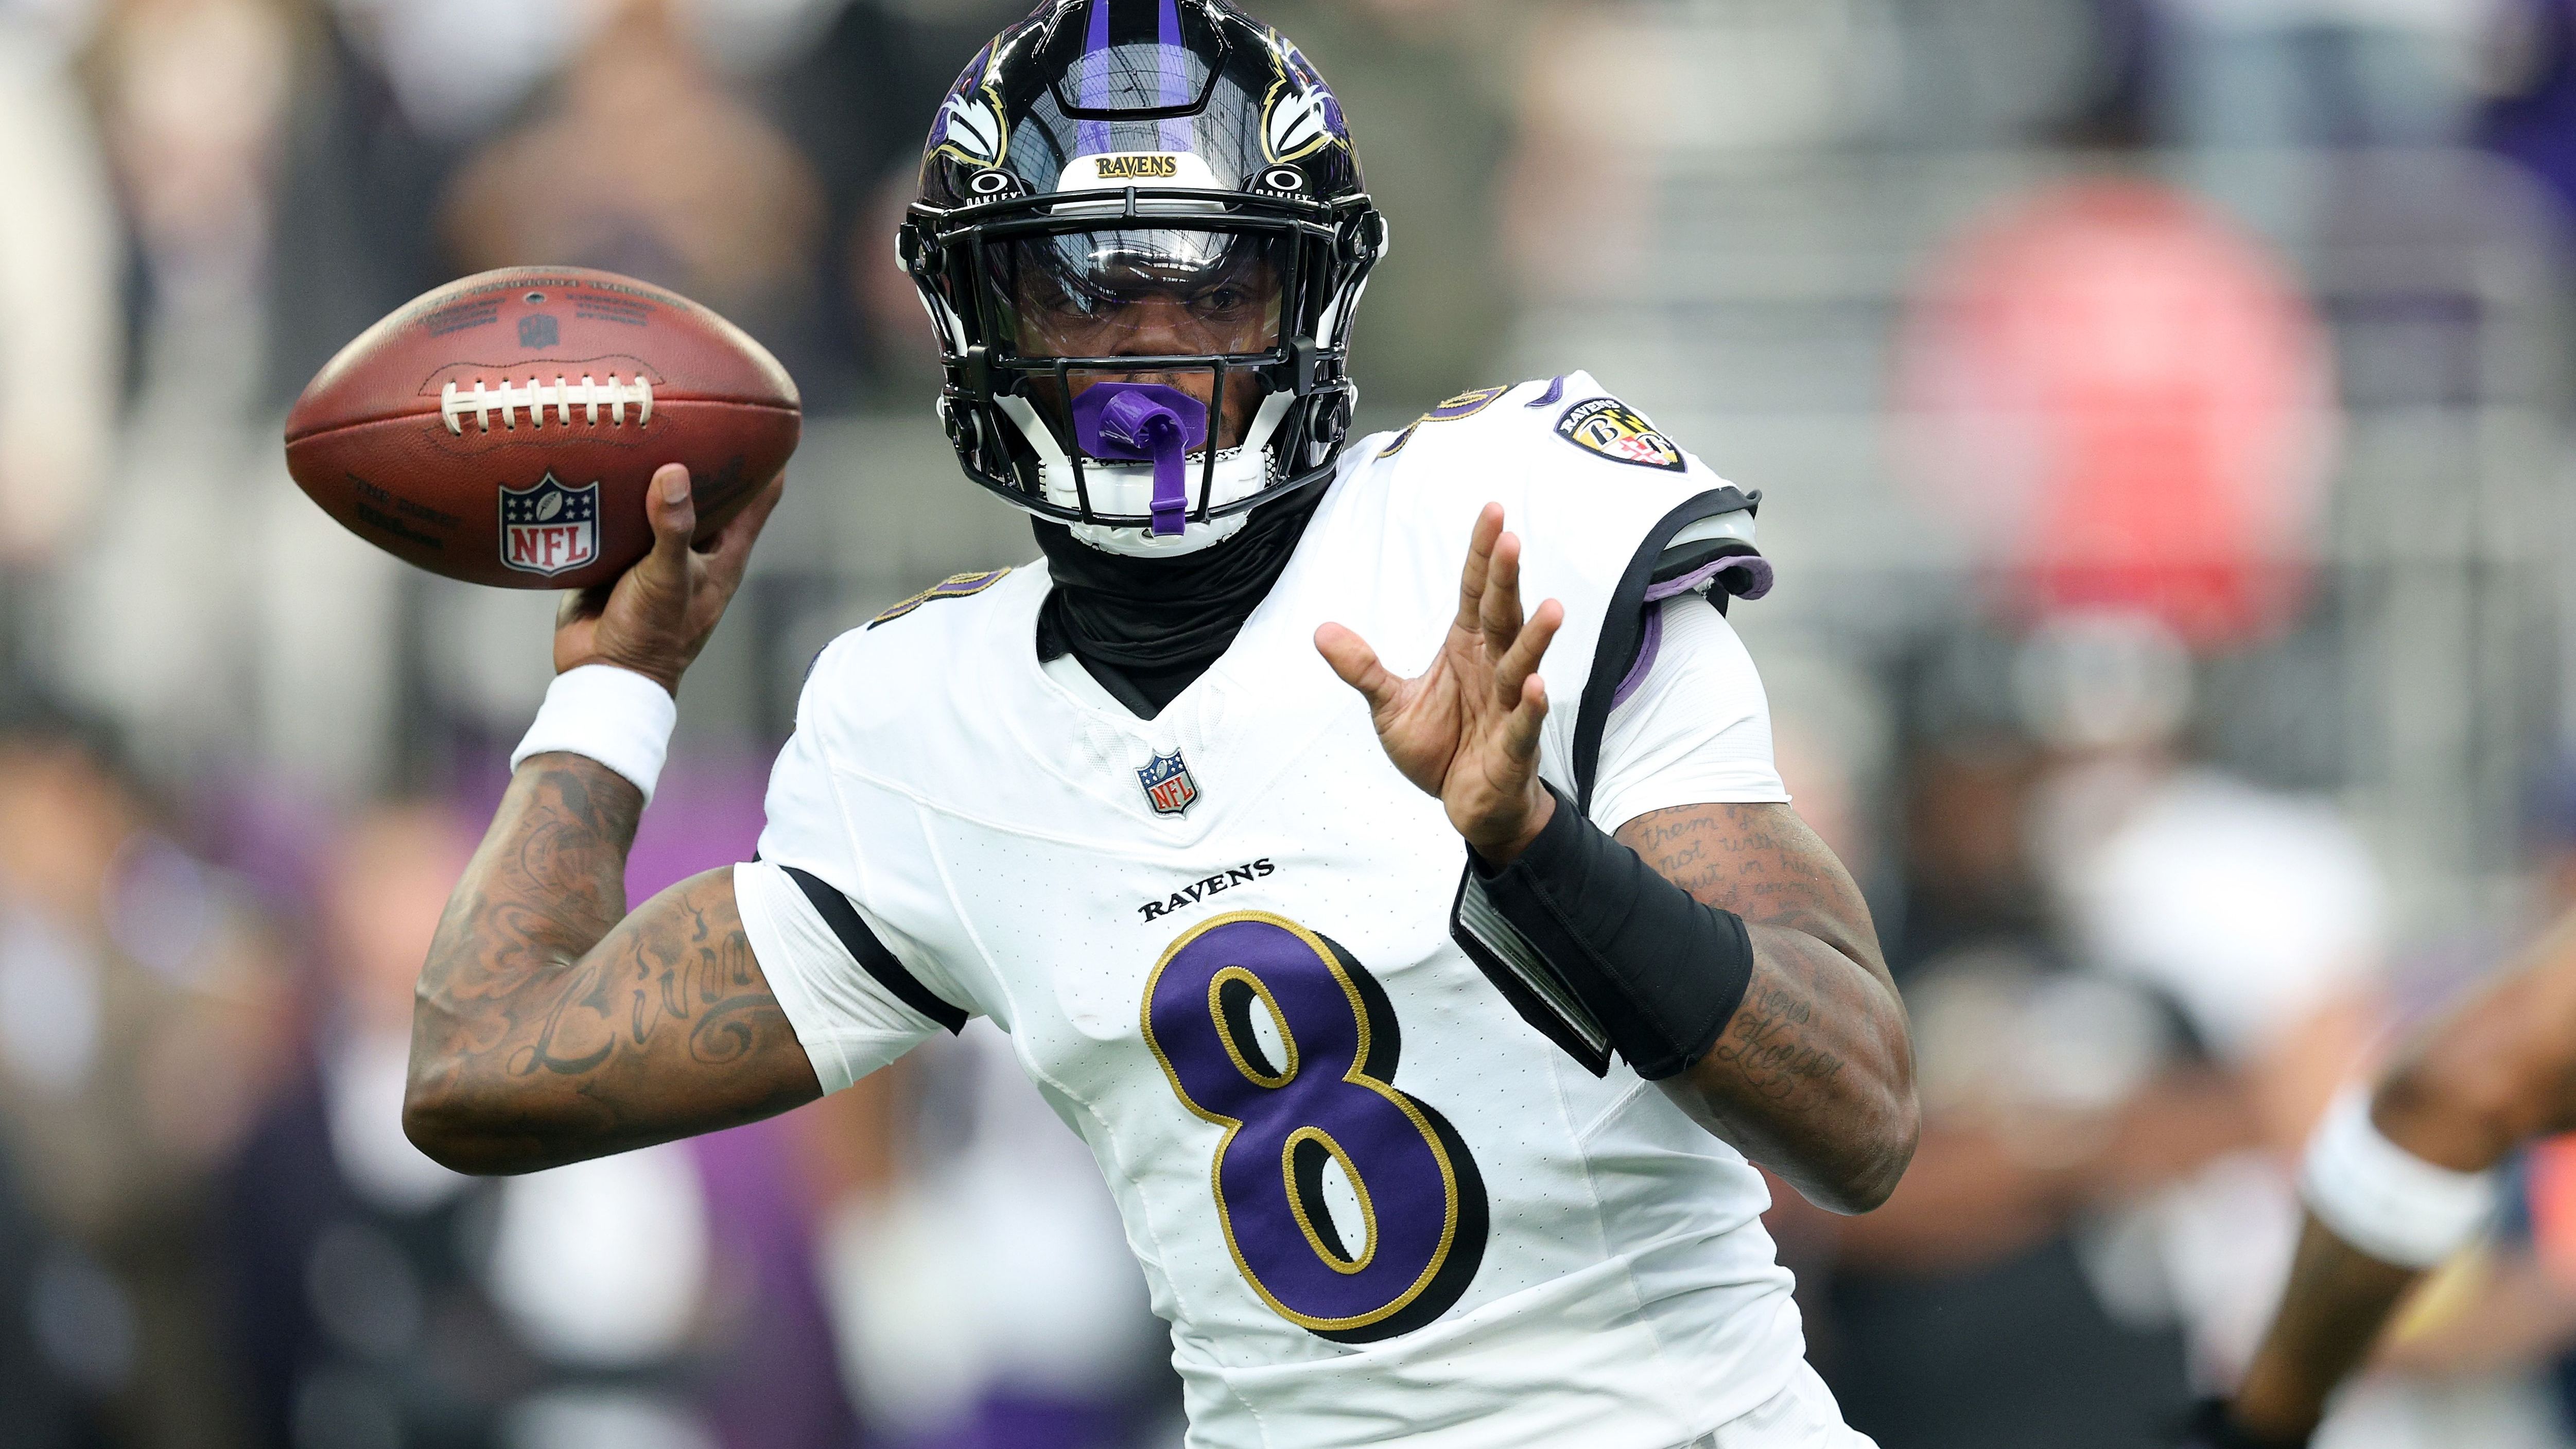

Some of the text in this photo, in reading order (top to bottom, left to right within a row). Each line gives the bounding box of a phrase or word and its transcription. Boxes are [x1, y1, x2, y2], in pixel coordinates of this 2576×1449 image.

[1095, 156, 1177, 180] RAVENS
[1560, 399, 1621, 434] RAVENS
[511, 526, 588, 568] NFL
[1150, 776, 1193, 809] NFL
[1138, 858, 1275, 923] RAVENS
[1140, 910, 1489, 1344] 8
